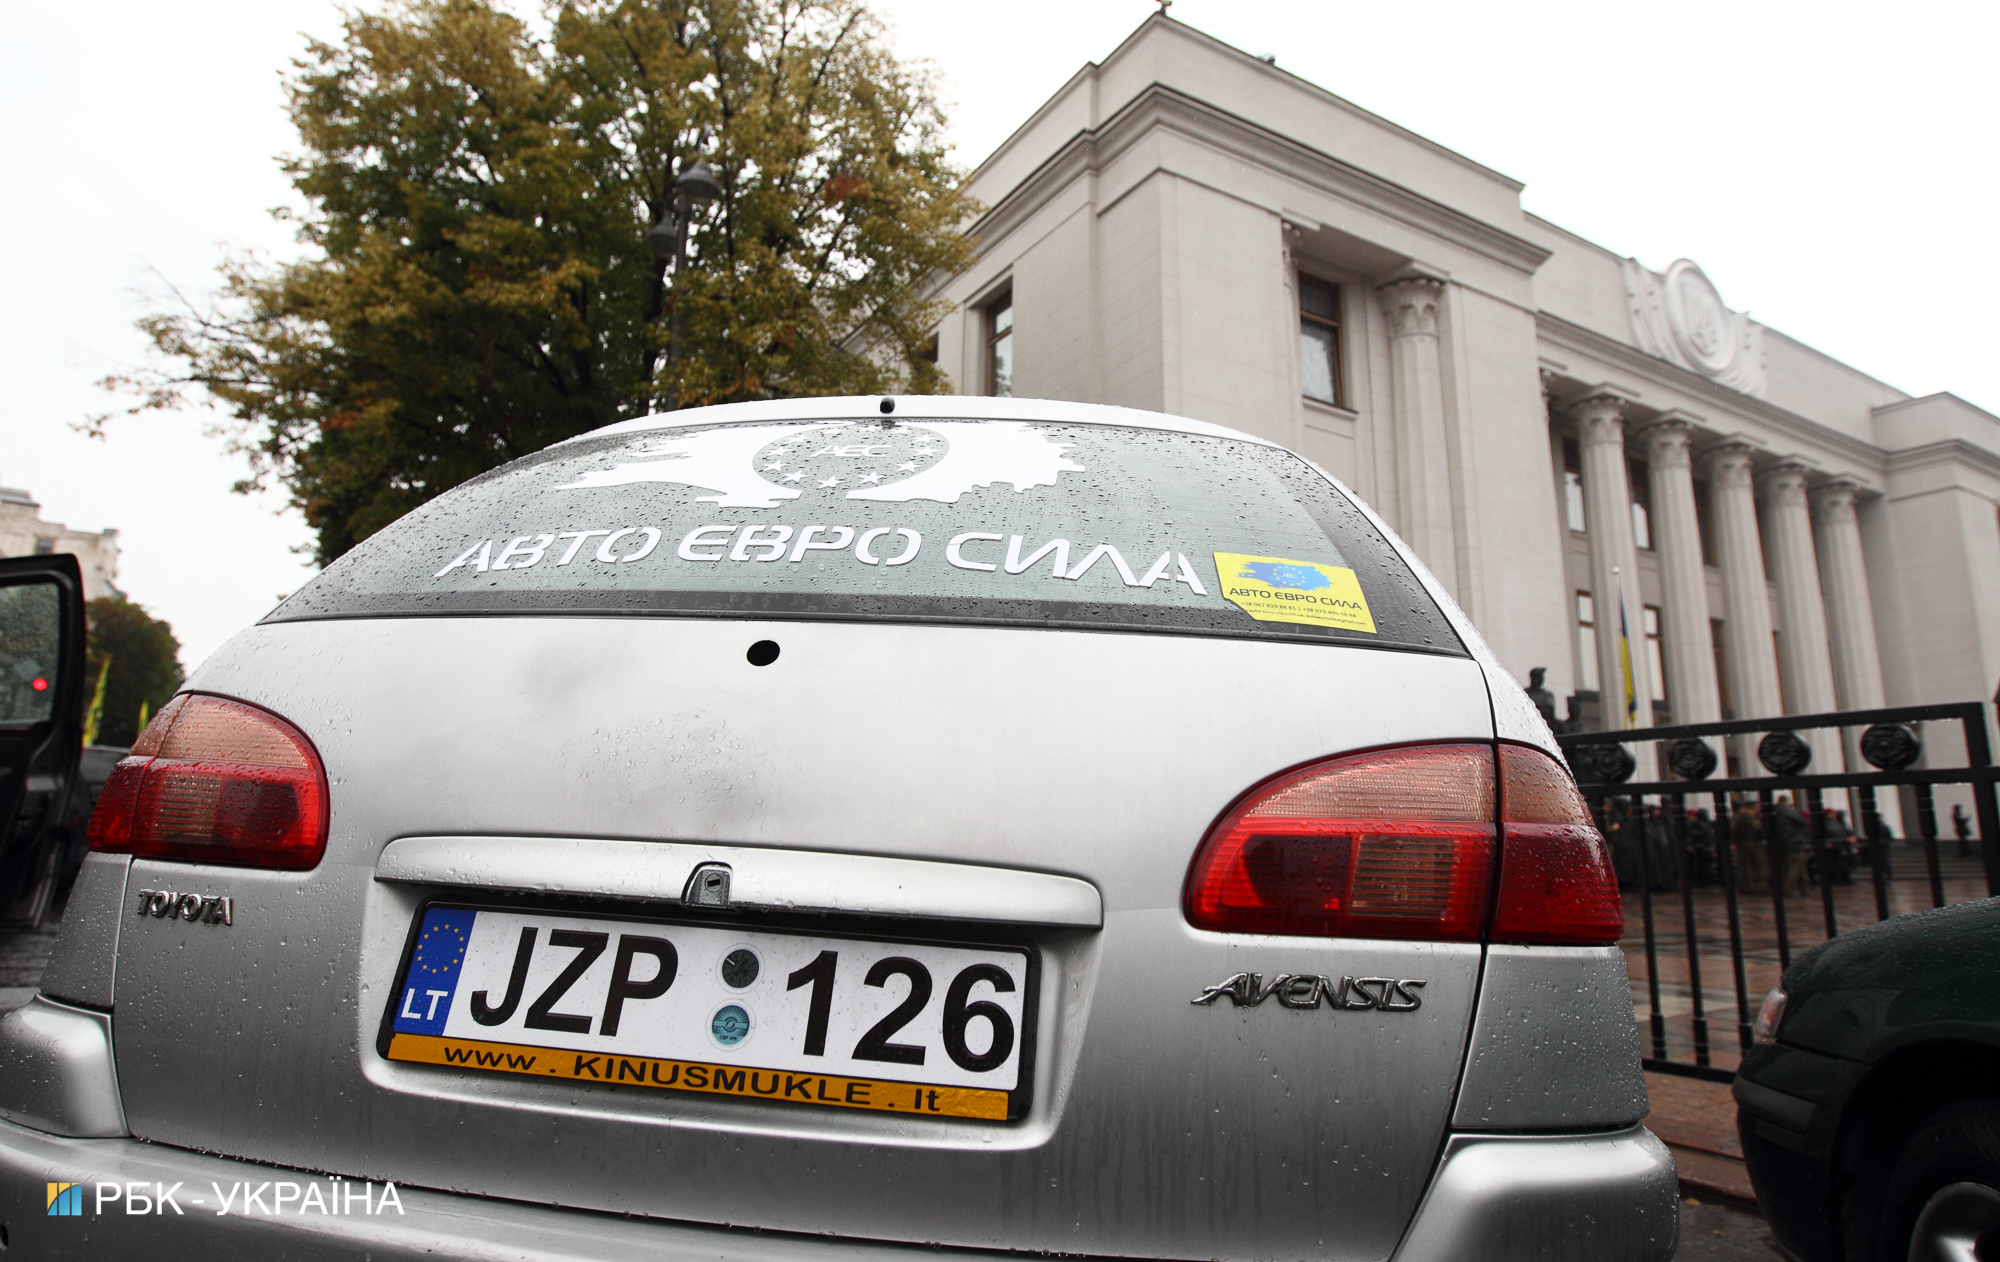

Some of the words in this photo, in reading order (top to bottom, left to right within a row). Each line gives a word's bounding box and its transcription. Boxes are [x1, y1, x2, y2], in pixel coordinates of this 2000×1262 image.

[433, 527, 662, 577] АВТО
[945, 532, 1208, 596] СИЛА
[1229, 587, 1271, 599] АВТО
[1320, 597, 1363, 610] СИЛА
[137, 889, 233, 927] TOYOTA
[401, 987, 449, 1021] LT
[470, 926, 679, 1037] JZP
[786, 950, 1016, 1073] 126
[1190, 972, 1427, 1013] AVENSIS
